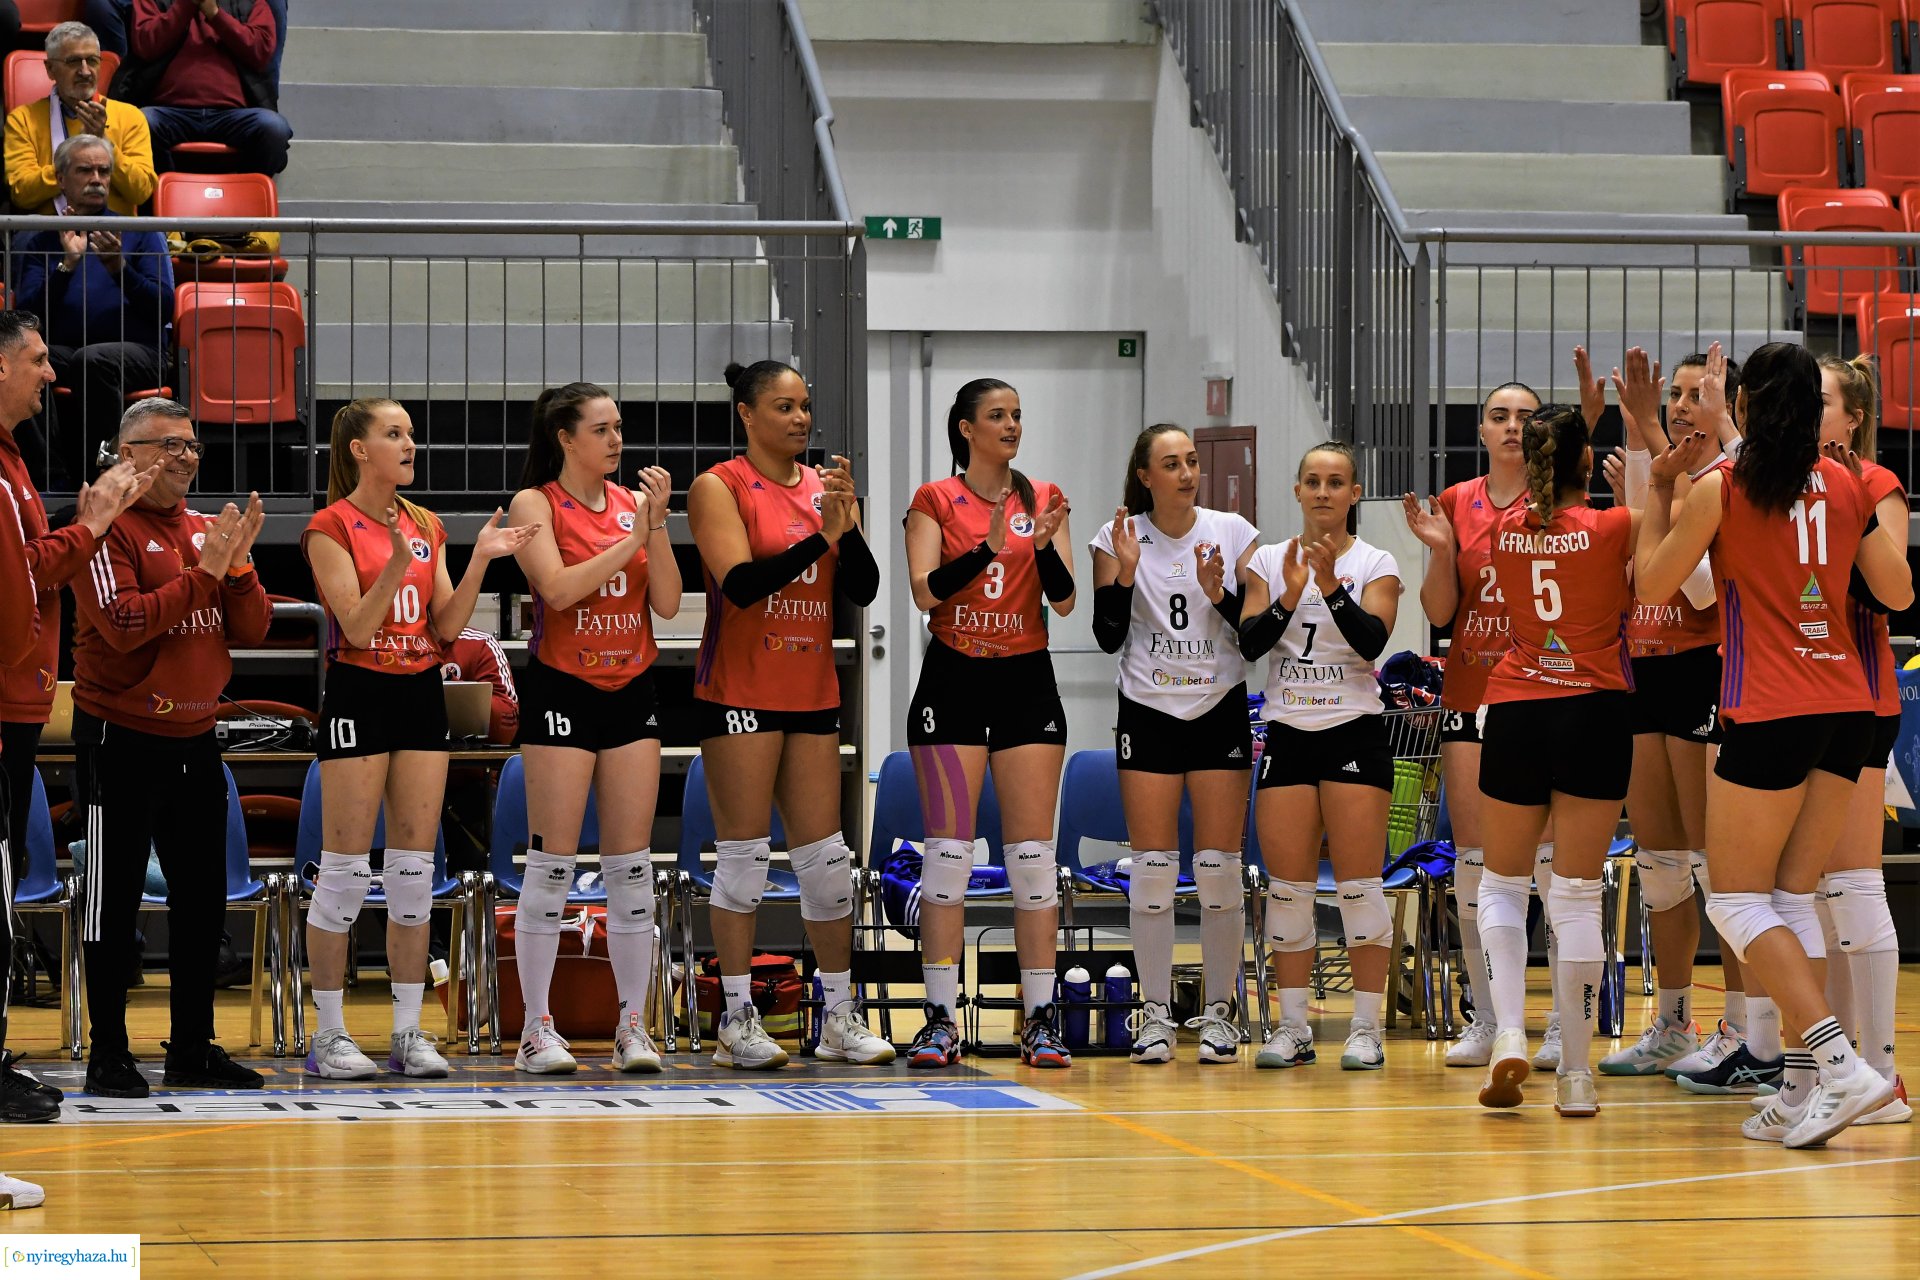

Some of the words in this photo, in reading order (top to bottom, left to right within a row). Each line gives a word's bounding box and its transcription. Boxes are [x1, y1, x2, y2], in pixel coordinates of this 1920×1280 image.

[1123, 343, 1132, 355] 3
[1789, 500, 1827, 565] 11
[984, 562, 1005, 599] 3
[1531, 560, 1563, 621] 5
[393, 584, 420, 624] 10
[764, 590, 828, 617] FATUM
[1169, 593, 1189, 630] 8
[1632, 604, 1683, 622] ATUM
[576, 607, 642, 630] FATUM
[952, 604, 1024, 629] FATUM
[1464, 609, 1511, 632] FATU
[368, 627, 433, 650] FATUM
[1150, 632, 1215, 654] FATUM
[1298, 622, 1317, 665] 7
[1278, 656, 1345, 681] FATUM
[1540, 659, 1573, 668] STRABAG
[1171, 676, 1203, 686] Többet
[1297, 695, 1326, 705] Többet
[544, 710, 571, 736] 15
[726, 710, 759, 734] 88
[922, 706, 936, 733] 3
[1442, 708, 1464, 731] 23
[330, 717, 357, 749] 10
[1120, 733, 1132, 760] 8
[1261, 755, 1272, 780] 7
[399, 868, 423, 876] MIKASA
[1199, 860, 1221, 868] MIKASA
[1465, 859, 1484, 867] MIKAS
[1584, 983, 1596, 1021] MIKASA
[72, 1096, 736, 1116] HÜBNER
